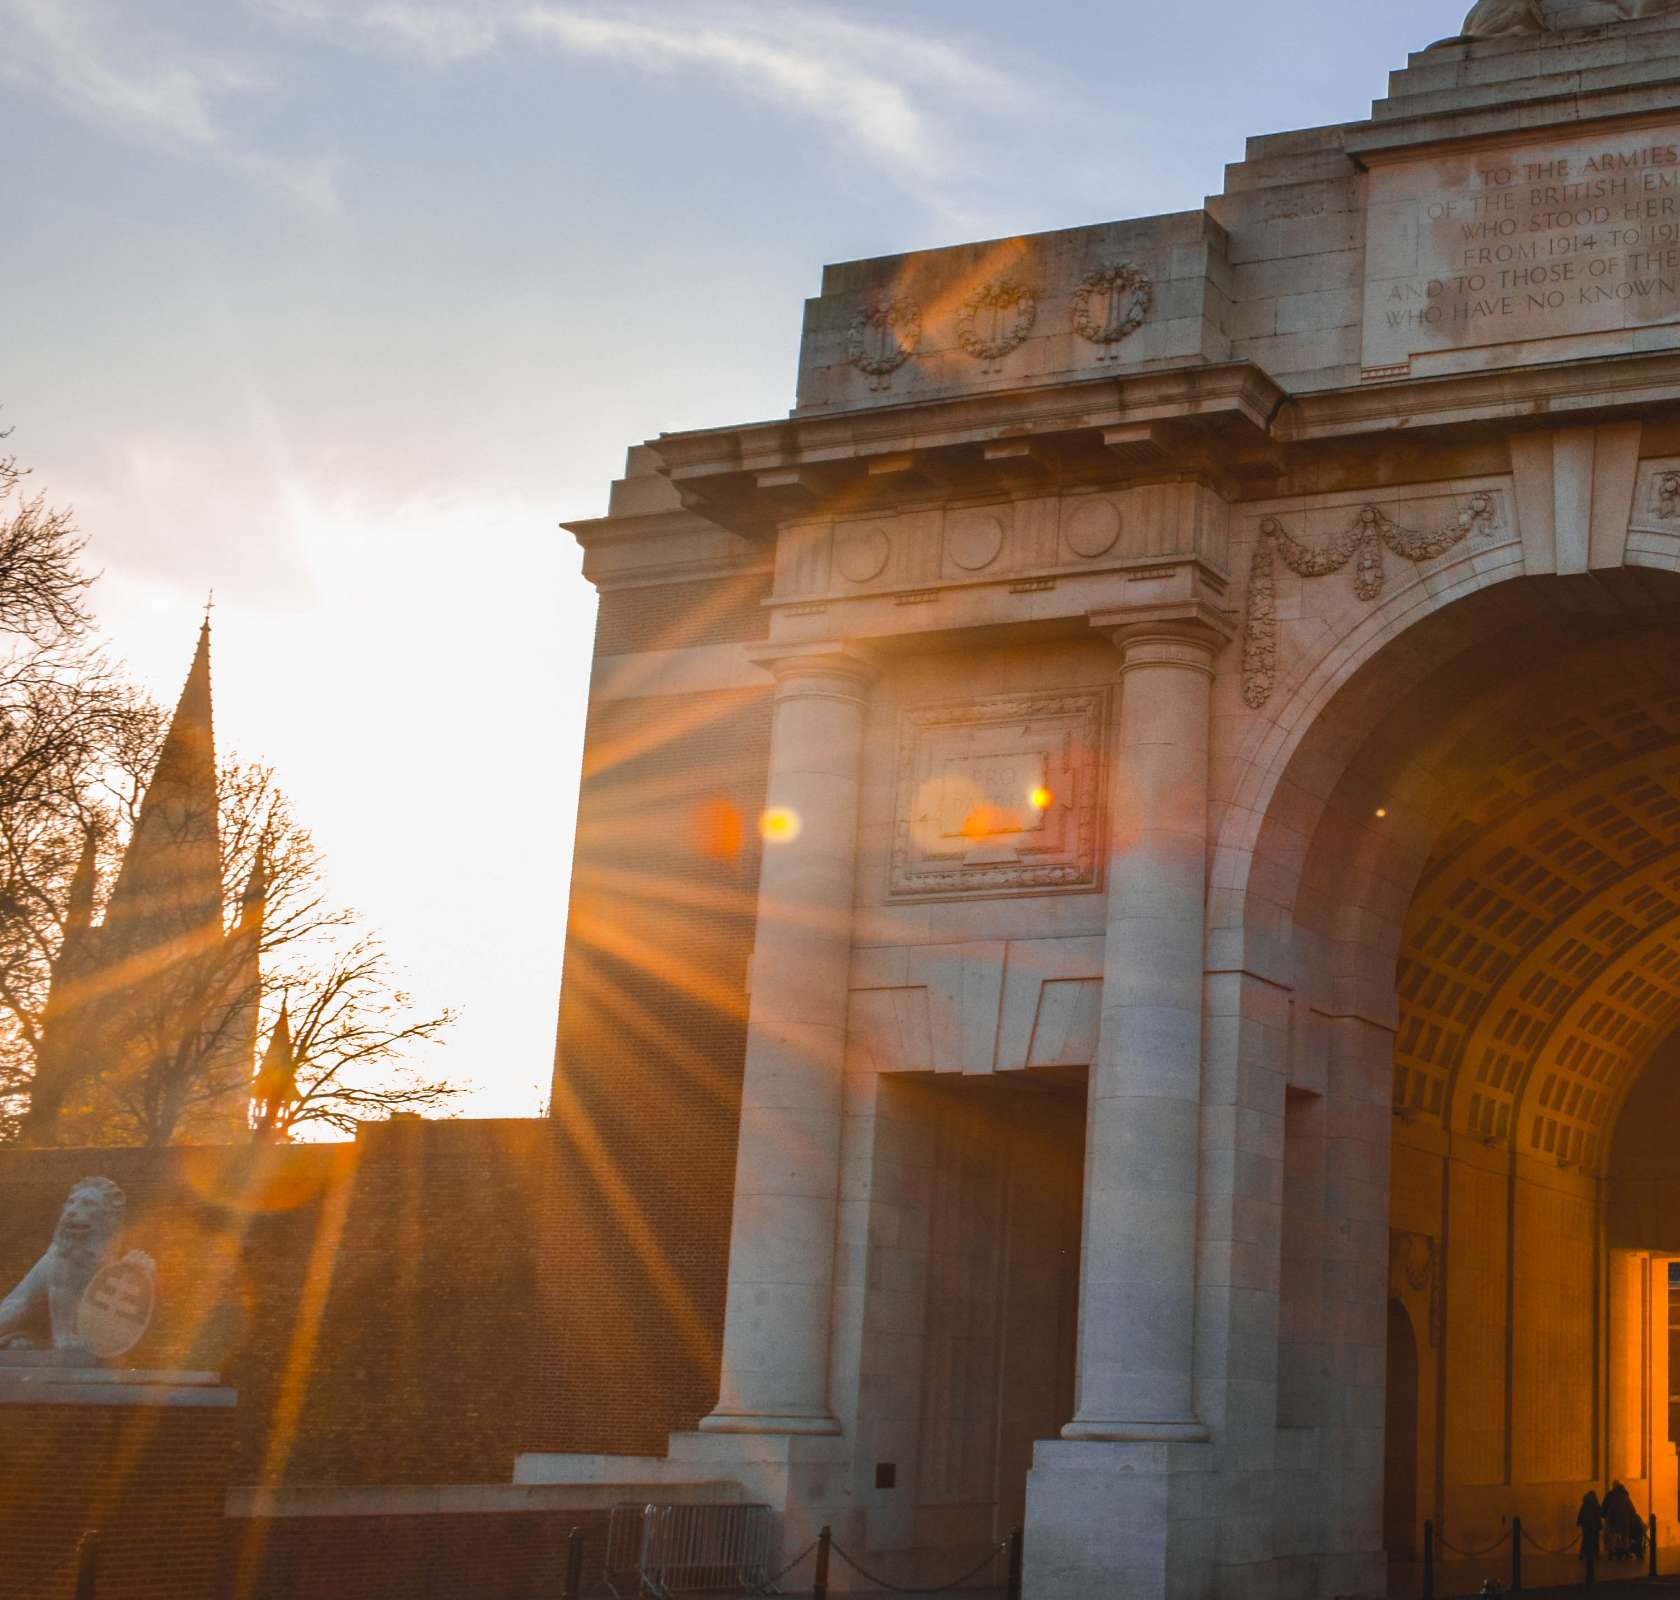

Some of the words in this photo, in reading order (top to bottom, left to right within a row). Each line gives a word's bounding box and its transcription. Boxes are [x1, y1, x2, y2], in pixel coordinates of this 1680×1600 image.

[1481, 167, 1512, 187] TO
[1523, 159, 1569, 180] THE
[1584, 144, 1679, 172] ARMIES
[1427, 201, 1458, 219] OF
[1472, 192, 1516, 213] THE
[1530, 177, 1627, 207] BRITISH
[1461, 218, 1517, 241] WHO
[1529, 207, 1610, 233] STOOD
[1463, 241, 1537, 266] FROM
[1549, 234, 1597, 256] 1914
[1608, 228, 1640, 247] TO
[1388, 279, 1444, 302] AND
[1456, 274, 1486, 295] TO
[1499, 262, 1575, 288] THOSE
[1588, 257, 1619, 277] OF
[1386, 306, 1442, 328] WHO
[1454, 297, 1514, 322] HAVE
[1527, 291, 1566, 312] NO
[1579, 278, 1676, 305] KNOWN
